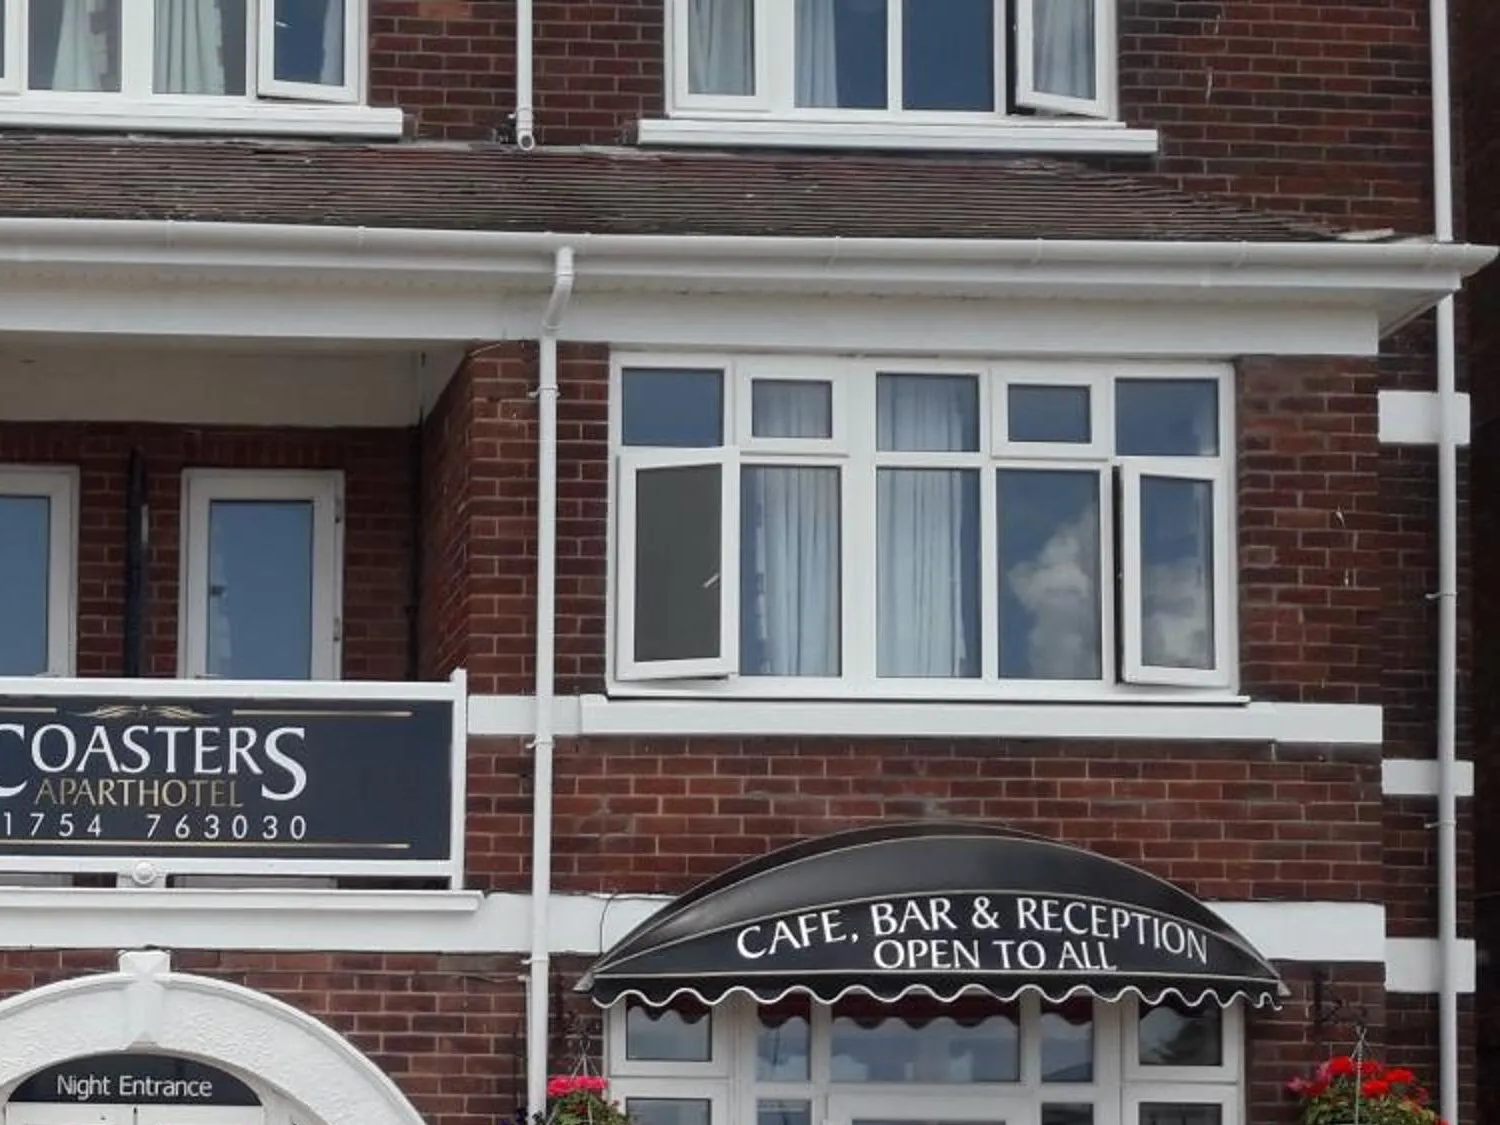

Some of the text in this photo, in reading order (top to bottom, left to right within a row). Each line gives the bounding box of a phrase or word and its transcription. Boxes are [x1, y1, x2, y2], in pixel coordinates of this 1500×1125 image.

[34, 777, 245, 807] APARTHOTEL
[147, 814, 306, 840] 763030
[737, 896, 1208, 966] CAFE, BAR & RECEPTION
[873, 939, 1118, 970] OPEN TO ALL
[57, 1074, 213, 1100] Night Entrance
